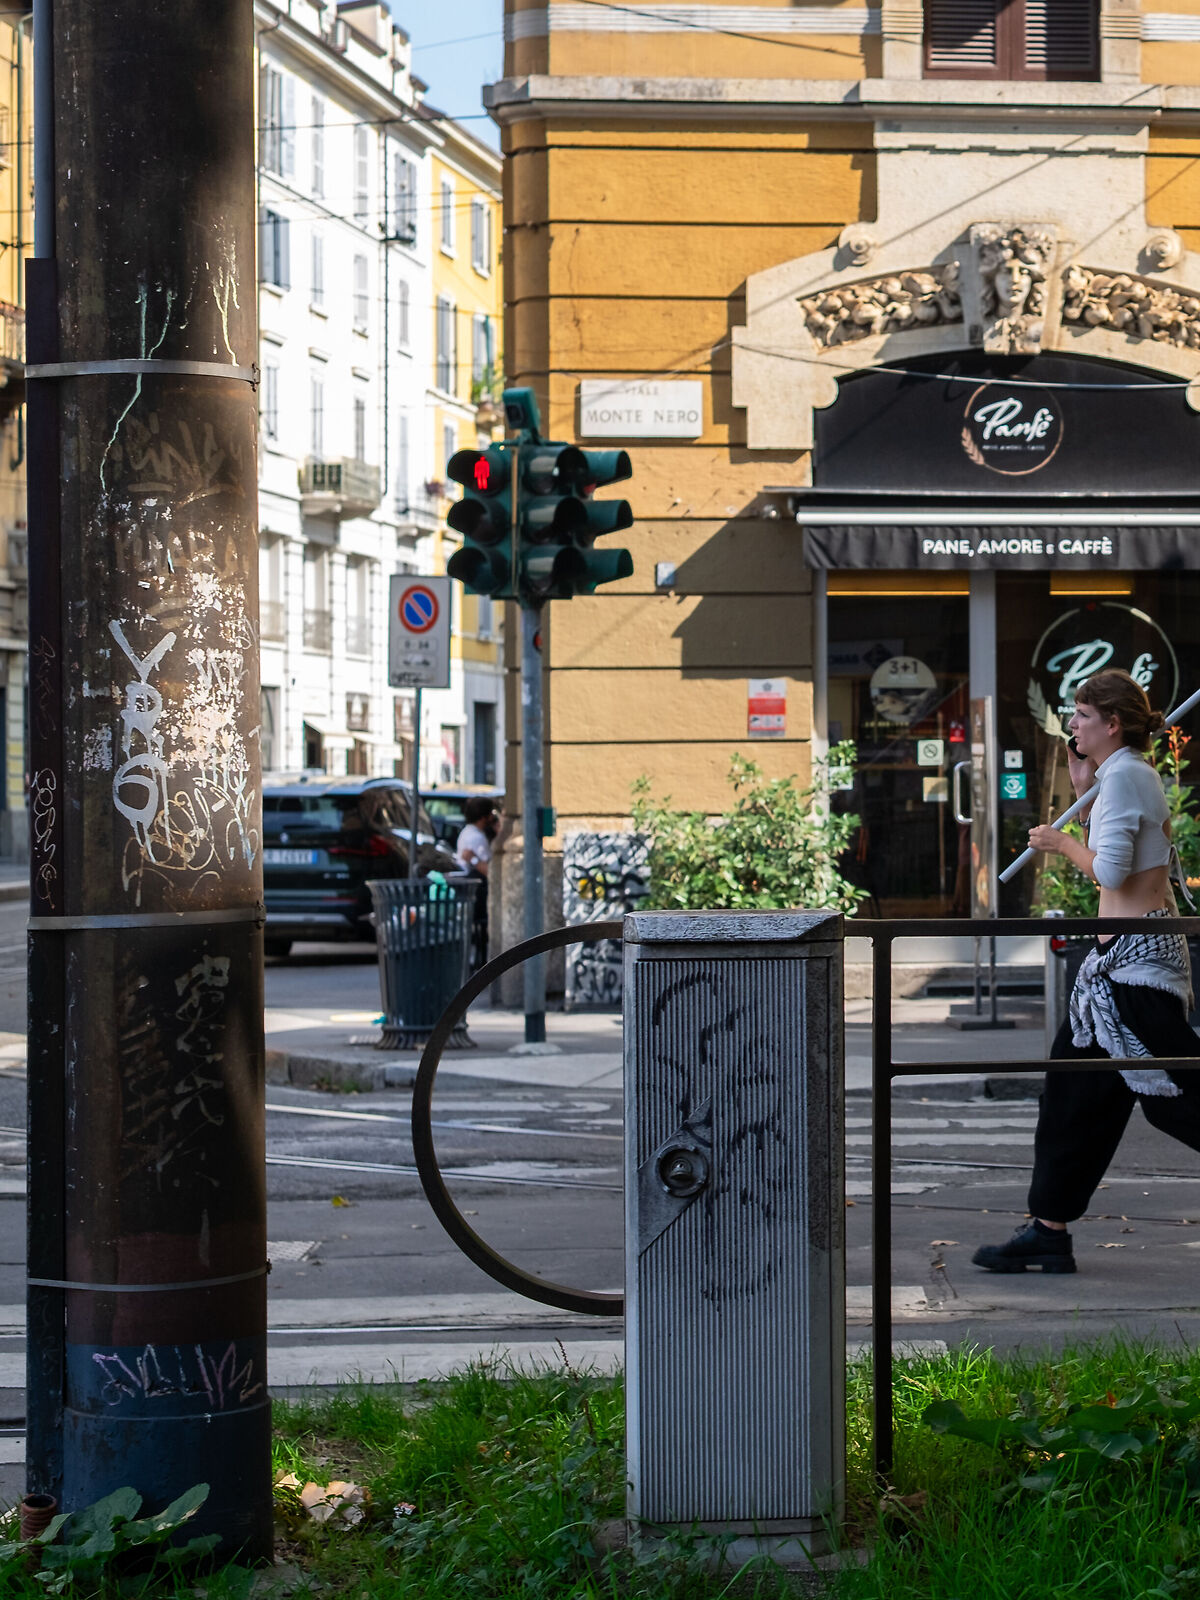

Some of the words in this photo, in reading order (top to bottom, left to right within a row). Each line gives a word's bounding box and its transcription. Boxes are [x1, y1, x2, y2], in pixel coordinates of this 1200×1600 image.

[585, 409, 643, 423] MONTE
[654, 409, 699, 423] NERO
[922, 539, 975, 558] PANE,
[977, 539, 1043, 555] AMORE
[1058, 536, 1113, 556] CAFFÈ
